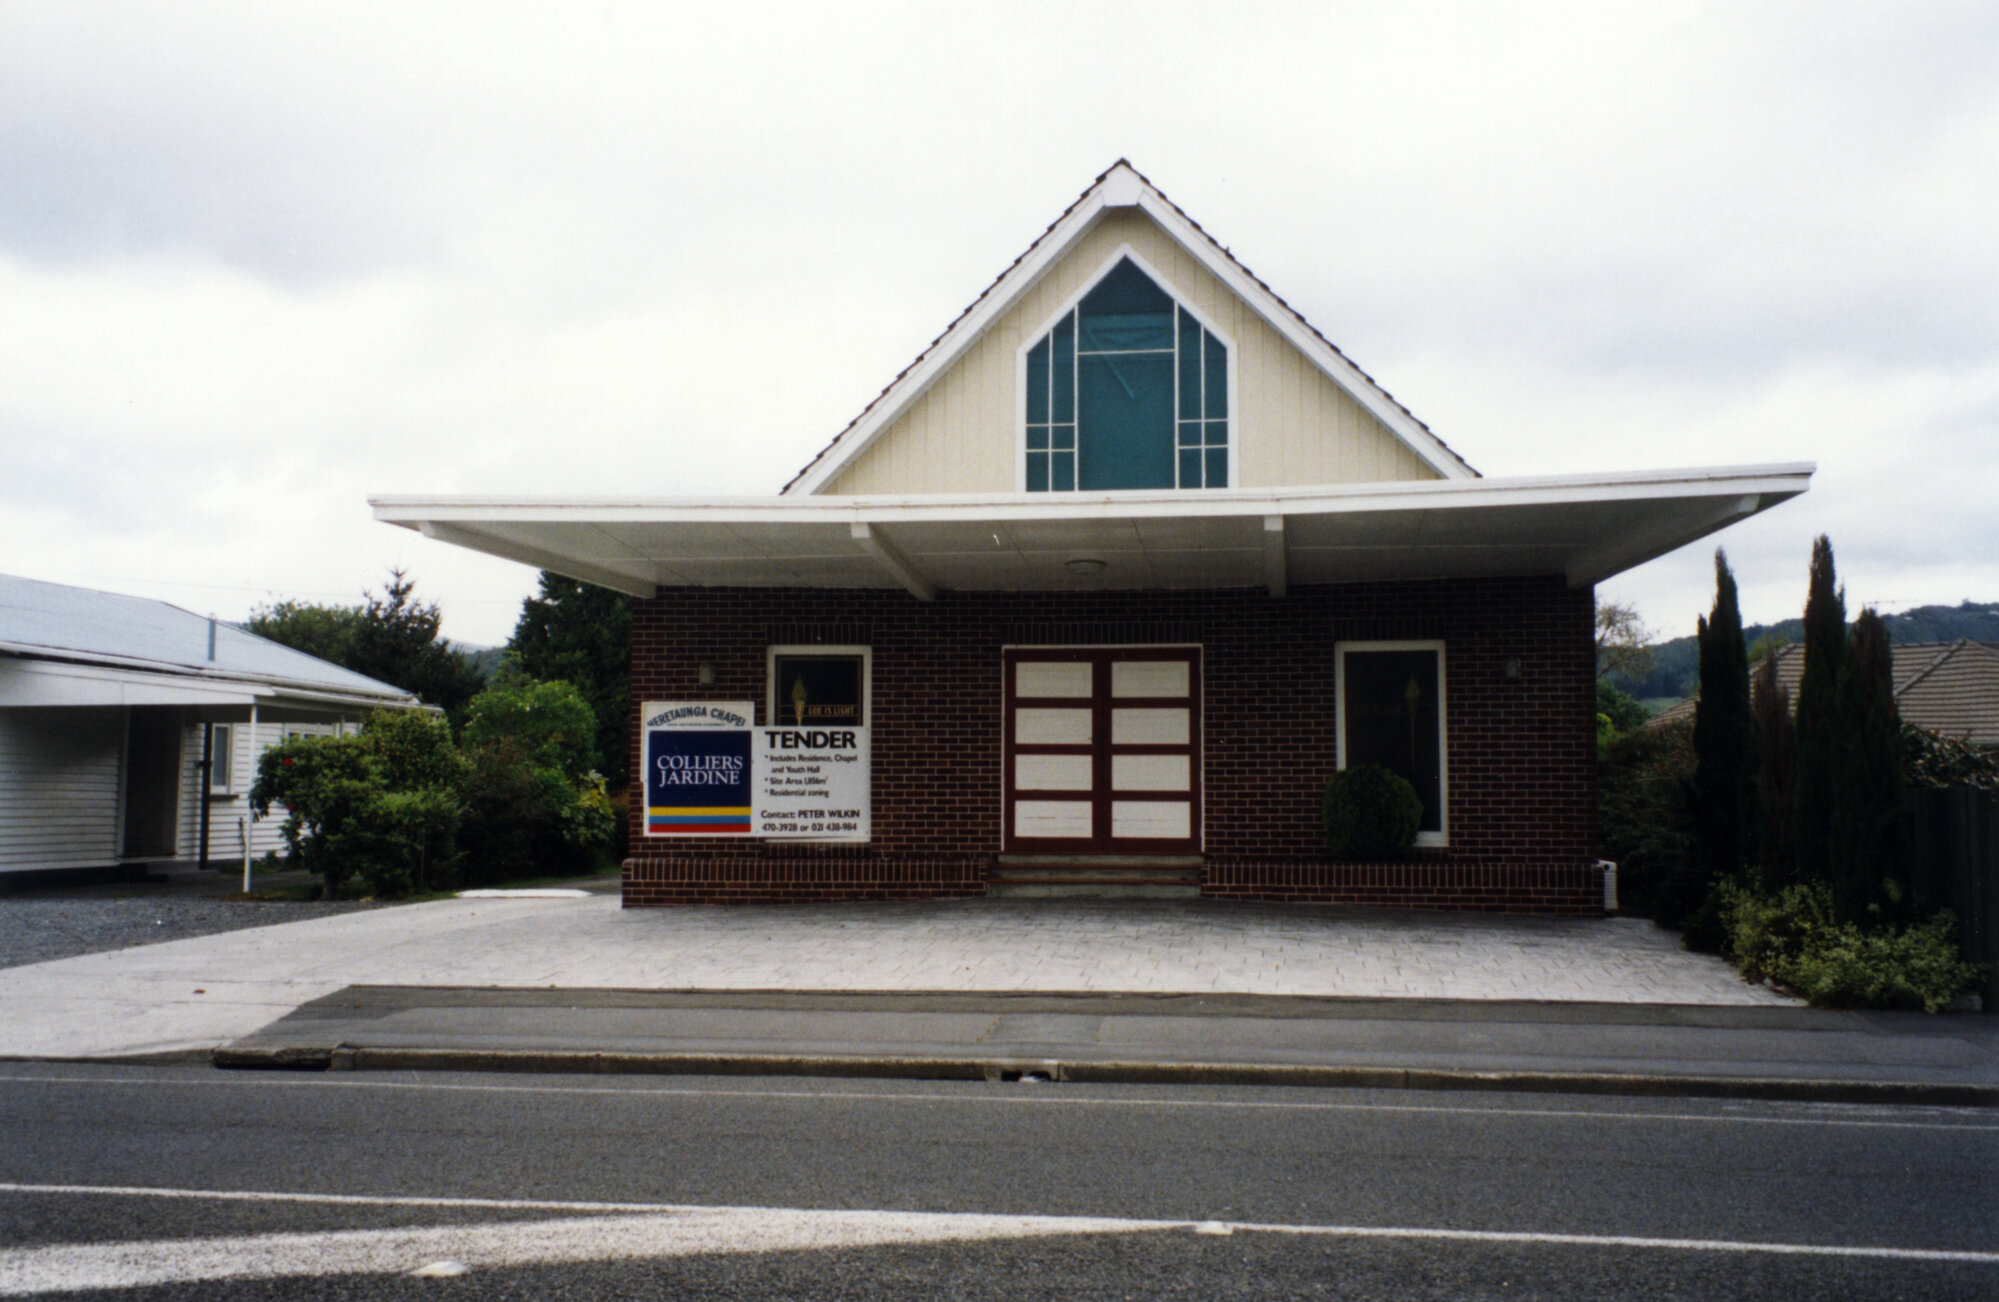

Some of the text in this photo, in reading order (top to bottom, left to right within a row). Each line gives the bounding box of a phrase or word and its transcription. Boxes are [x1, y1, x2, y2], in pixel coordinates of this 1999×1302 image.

[765, 731, 857, 749] TENDER
[657, 755, 743, 770] COLLIERS
[770, 754, 858, 764] Includes Residence, Chapel
[659, 770, 740, 787] JARDINE
[770, 777, 783, 785] Site
[785, 777, 803, 785] Area
[808, 789, 830, 798] zoning
[760, 809, 860, 819] Contact: PETER WILKIN
[762, 823, 797, 832] 470-3928
[811, 823, 824, 831] 021
